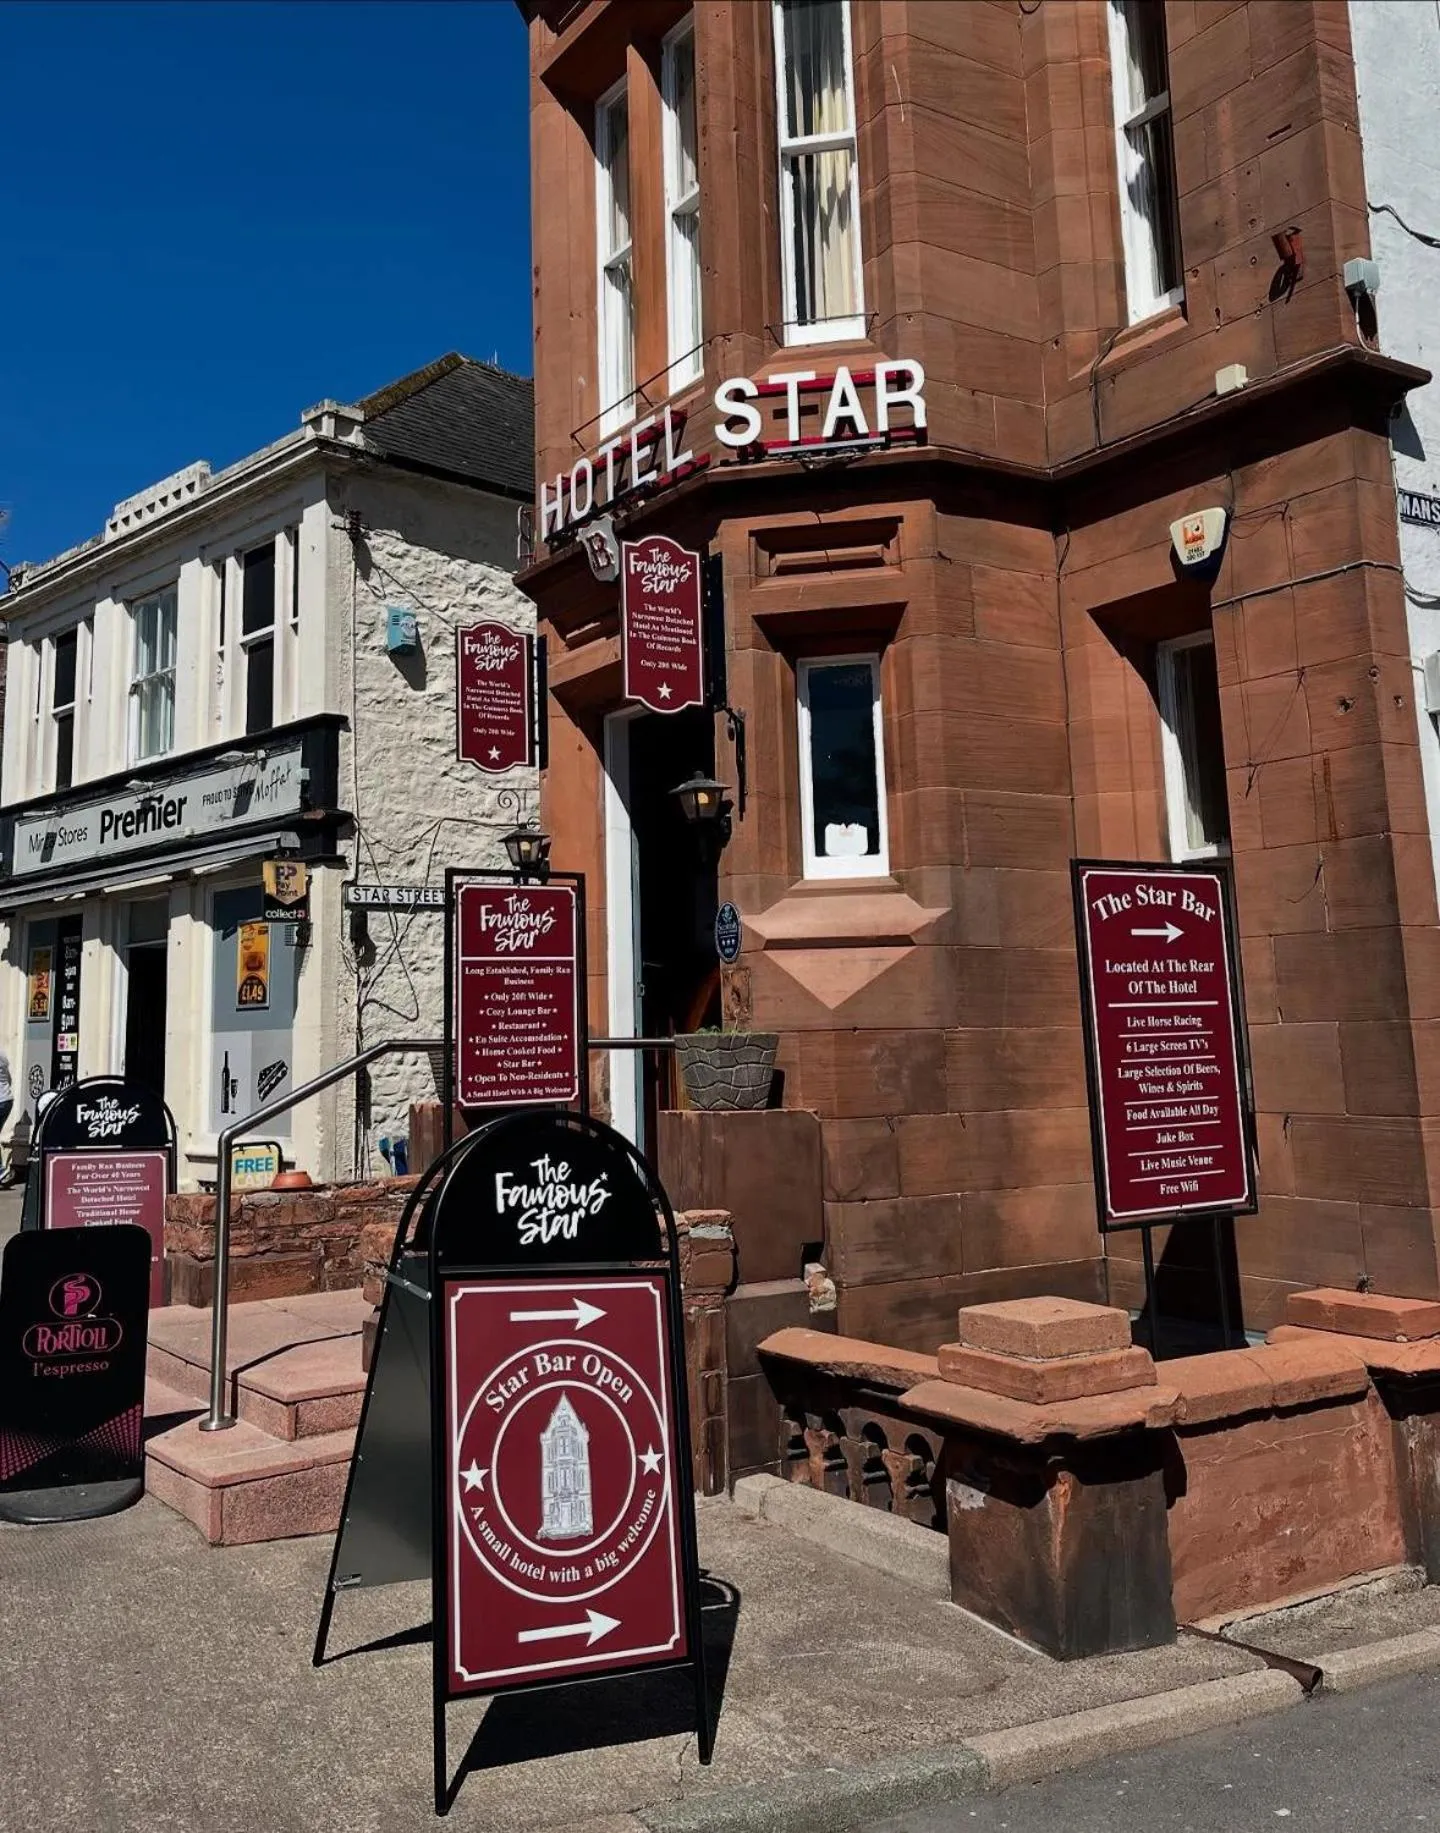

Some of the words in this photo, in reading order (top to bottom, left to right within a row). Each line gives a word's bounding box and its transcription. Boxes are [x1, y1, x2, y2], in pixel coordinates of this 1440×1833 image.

[714, 358, 928, 447] STAR
[541, 405, 693, 541] HOTEL
[649, 547, 671, 563] The
[629, 553, 692, 582] Famous
[641, 575, 679, 593] Star
[644, 603, 656, 611] The
[481, 630, 501, 645] The
[638, 631, 651, 639] The
[464, 636, 520, 660] Famous
[474, 654, 508, 671] Star
[202, 790, 223, 807] PROUD
[224, 788, 232, 801] TO
[100, 796, 188, 844] Premier
[58, 826, 88, 847] Stores
[353, 887, 391, 902] STAR
[1091, 892, 1132, 921] The
[1135, 884, 1177, 906] Star
[1181, 889, 1216, 922] Bar
[504, 893, 532, 914] The
[480, 904, 558, 932] Famous
[494, 928, 540, 952] Star
[465, 966, 485, 976] Long
[485, 966, 529, 976] Established,
[530, 966, 553, 975] Family
[1105, 959, 1149, 973] Located
[1151, 960, 1165, 973] At
[1167, 960, 1187, 972] The
[1189, 959, 1215, 972] Rear
[503, 977, 534, 986] Business
[1128, 981, 1144, 995] Of
[1146, 981, 1166, 994] The
[1169, 980, 1198, 993] Hotel
[490, 992, 509, 1003] Only
[511, 992, 526, 1001] 20ft
[527, 992, 548, 1000] Wide
[486, 1007, 505, 1018] Cozy
[507, 1007, 536, 1017] Lounge
[537, 1006, 552, 1015] Bar
[498, 1021, 540, 1030] Restaurant
[1127, 1016, 1146, 1028] Live
[1147, 1015, 1172, 1027] Horse
[1173, 1014, 1203, 1028] Racing
[475, 1035, 487, 1044] En
[488, 1034, 508, 1044] Suite
[1126, 1042, 1132, 1053] 6
[1133, 1041, 1158, 1055] Large
[1160, 1040, 1187, 1051] Screen
[1188, 1038, 1209, 1050] TV's
[482, 1047, 505, 1056] Home
[506, 1046, 536, 1055] Cooked
[537, 1045, 556, 1054] Food
[503, 1060, 520, 1068] Star
[521, 1059, 536, 1068] Bar
[1117, 1067, 1144, 1080] Large
[1144, 1065, 1182, 1077] Selection
[1183, 1065, 1195, 1075] Of
[1195, 1063, 1221, 1075] Beers,
[474, 1074, 496, 1085] Open
[497, 1073, 508, 1081] To
[509, 1071, 563, 1081] Non-Residents
[472, 1089, 491, 1098] Small
[533, 1087, 544, 1096] Big
[1138, 1083, 1164, 1094] Wines
[1166, 1083, 1175, 1093] &
[1176, 1080, 1204, 1095] Spirits
[96, 1096, 119, 1109] The
[76, 1104, 141, 1124] Famous
[1126, 1108, 1148, 1121] Food
[1149, 1106, 1188, 1119] Available
[1188, 1105, 1201, 1116] All
[1202, 1104, 1219, 1117] Day
[87, 1120, 126, 1138] Star
[1155, 1132, 1177, 1145] Juke
[1178, 1131, 1195, 1141] Box
[71, 1162, 96, 1171] Family
[235, 1157, 273, 1174] FREE
[530, 1153, 572, 1186] The
[1140, 1160, 1159, 1172] Live
[1161, 1157, 1187, 1170] Music
[1188, 1154, 1213, 1166] Venue
[67, 1187, 81, 1195] The
[82, 1186, 112, 1194] World's
[495, 1172, 612, 1215] Famous
[1159, 1183, 1179, 1195] Free
[1180, 1180, 1199, 1193] Wifi
[76, 1209, 117, 1218] Traditional
[119, 1208, 140, 1216] Home
[517, 1206, 586, 1245] Star
[33, 1361, 109, 1379] l'espresso
[485, 1366, 529, 1413] Star
[533, 1352, 576, 1377] Bar
[581, 1353, 634, 1404] Open
[471, 1505, 482, 1520] A
[478, 1522, 511, 1562] small
[510, 1551, 545, 1582] hotel
[549, 1568, 581, 1583] with
[585, 1566, 593, 1577] a
[596, 1550, 620, 1571] big
[617, 1489, 656, 1552] welcome
